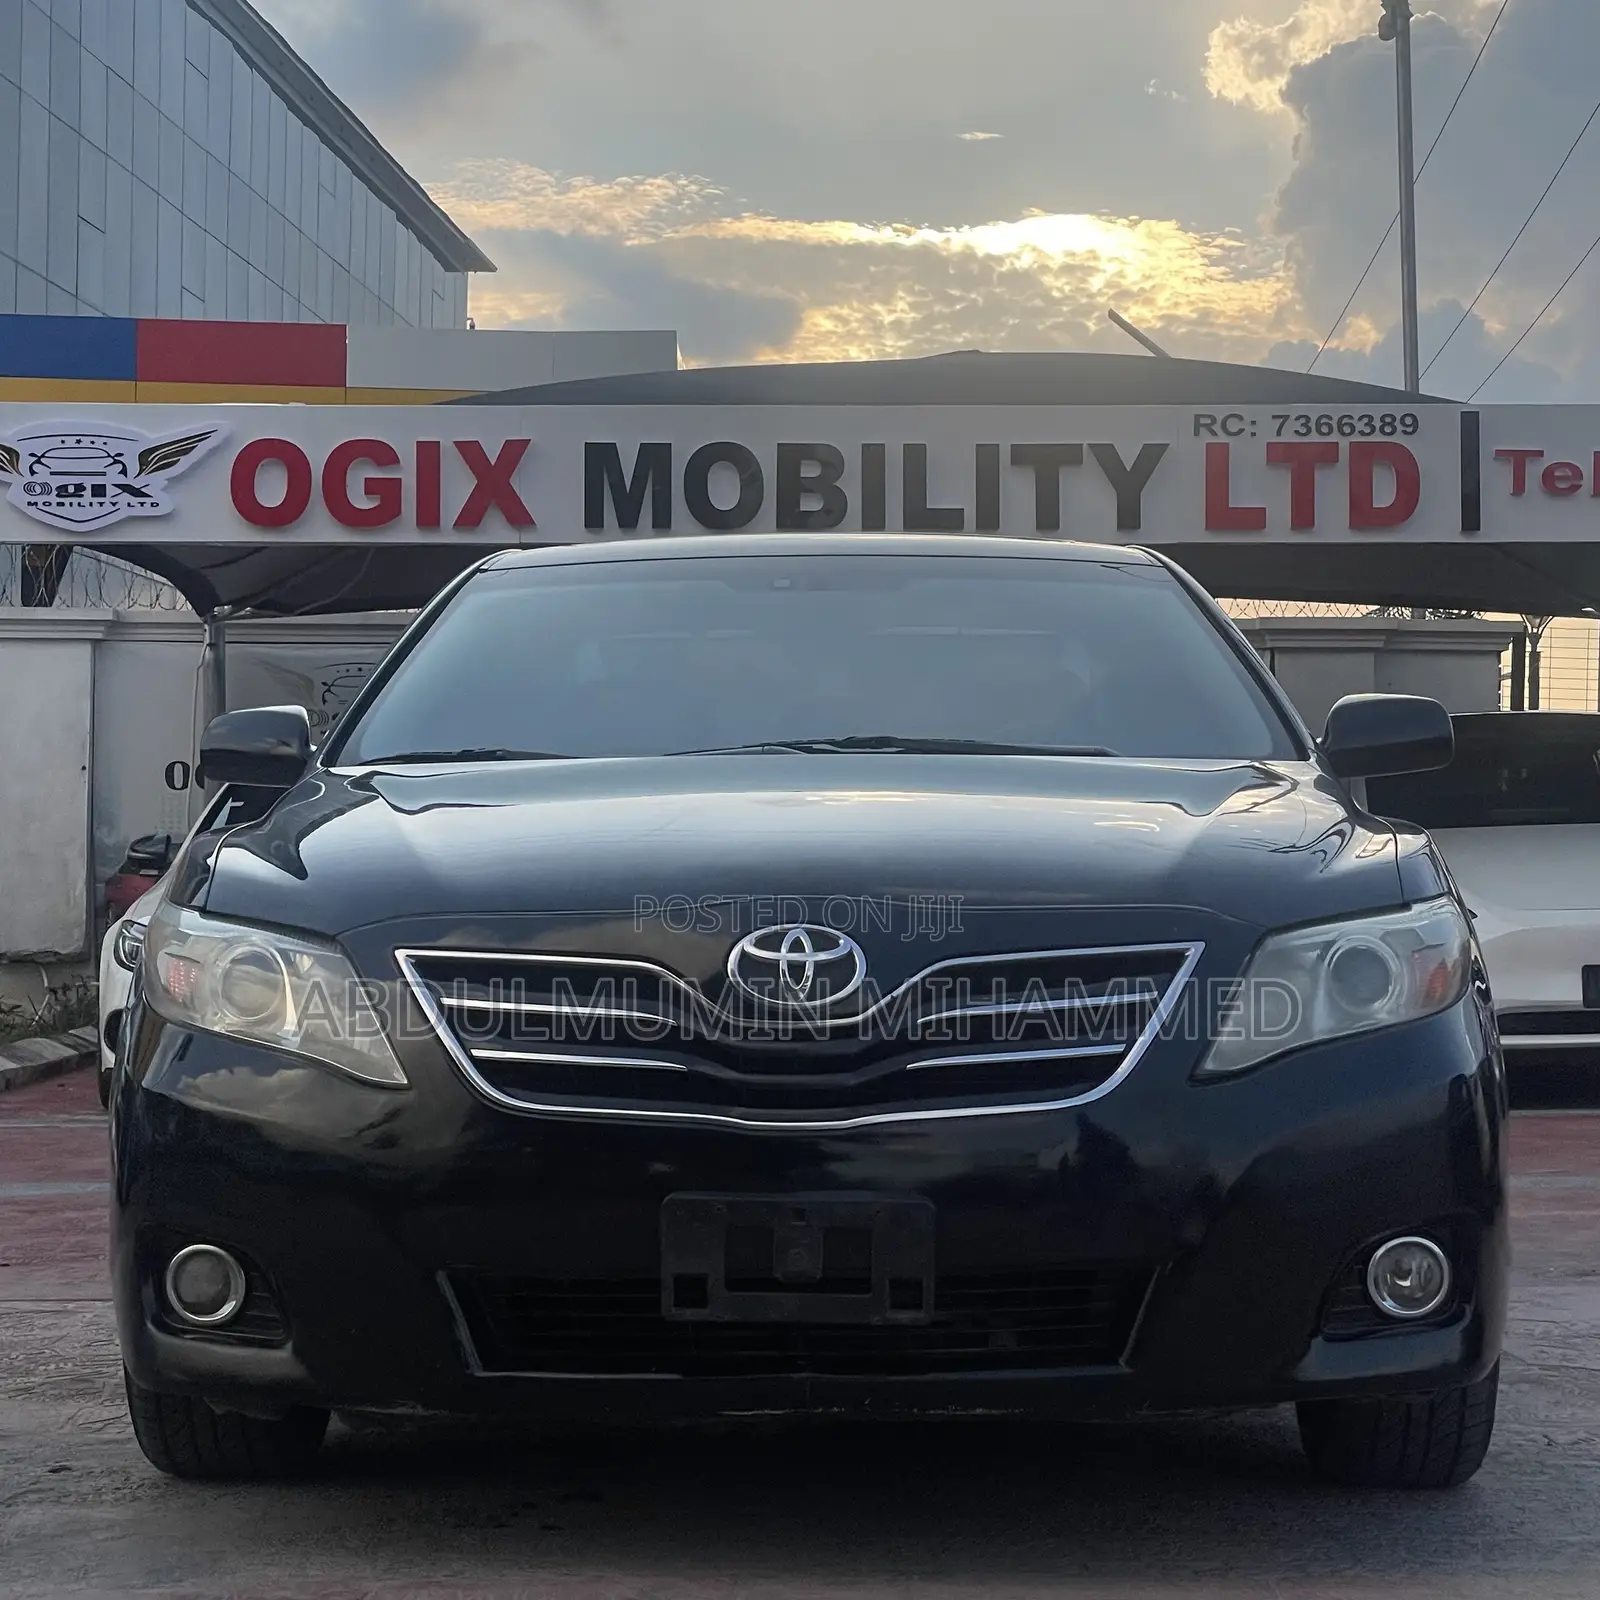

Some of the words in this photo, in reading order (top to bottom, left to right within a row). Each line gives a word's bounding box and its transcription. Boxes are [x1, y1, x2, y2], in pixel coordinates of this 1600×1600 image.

[1193, 413, 1257, 437] RC:
[1271, 413, 1419, 437] 7366389
[230, 438, 536, 528] OGIX
[584, 441, 1170, 531] MOBILITY
[1205, 442, 1421, 530] LTD
